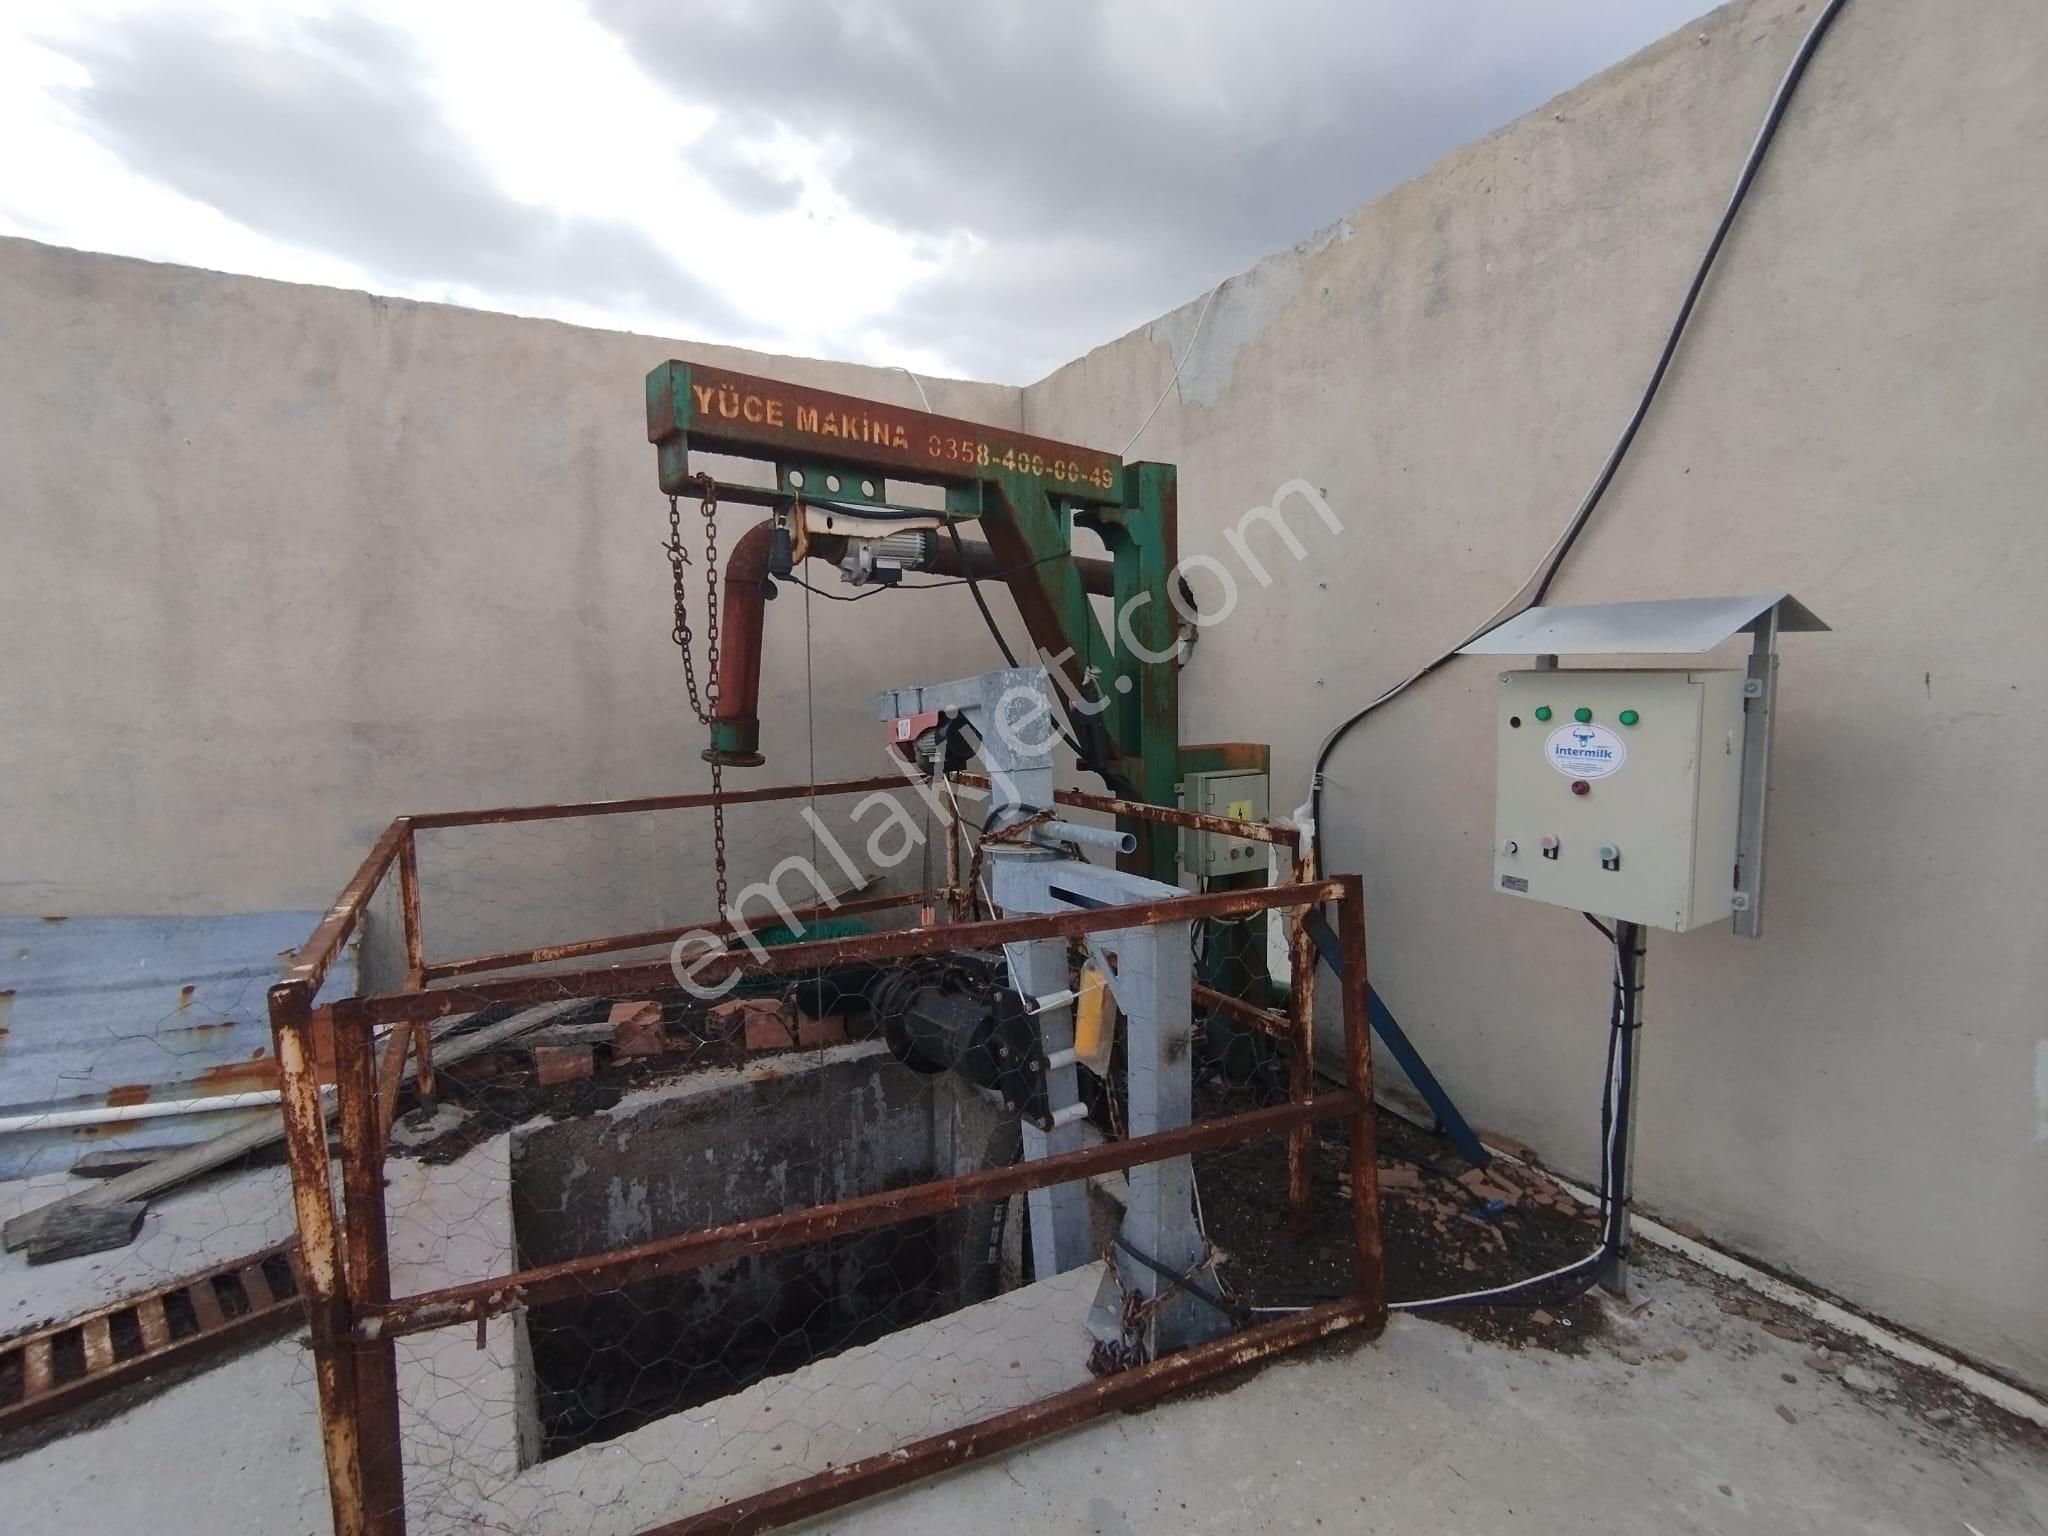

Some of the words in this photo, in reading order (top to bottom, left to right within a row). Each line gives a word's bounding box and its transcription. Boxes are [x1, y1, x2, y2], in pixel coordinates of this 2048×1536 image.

[692, 383, 784, 427] YÜCE
[928, 435, 1114, 489] 0358-400-00-49
[1555, 743, 1612, 759] intermilk
